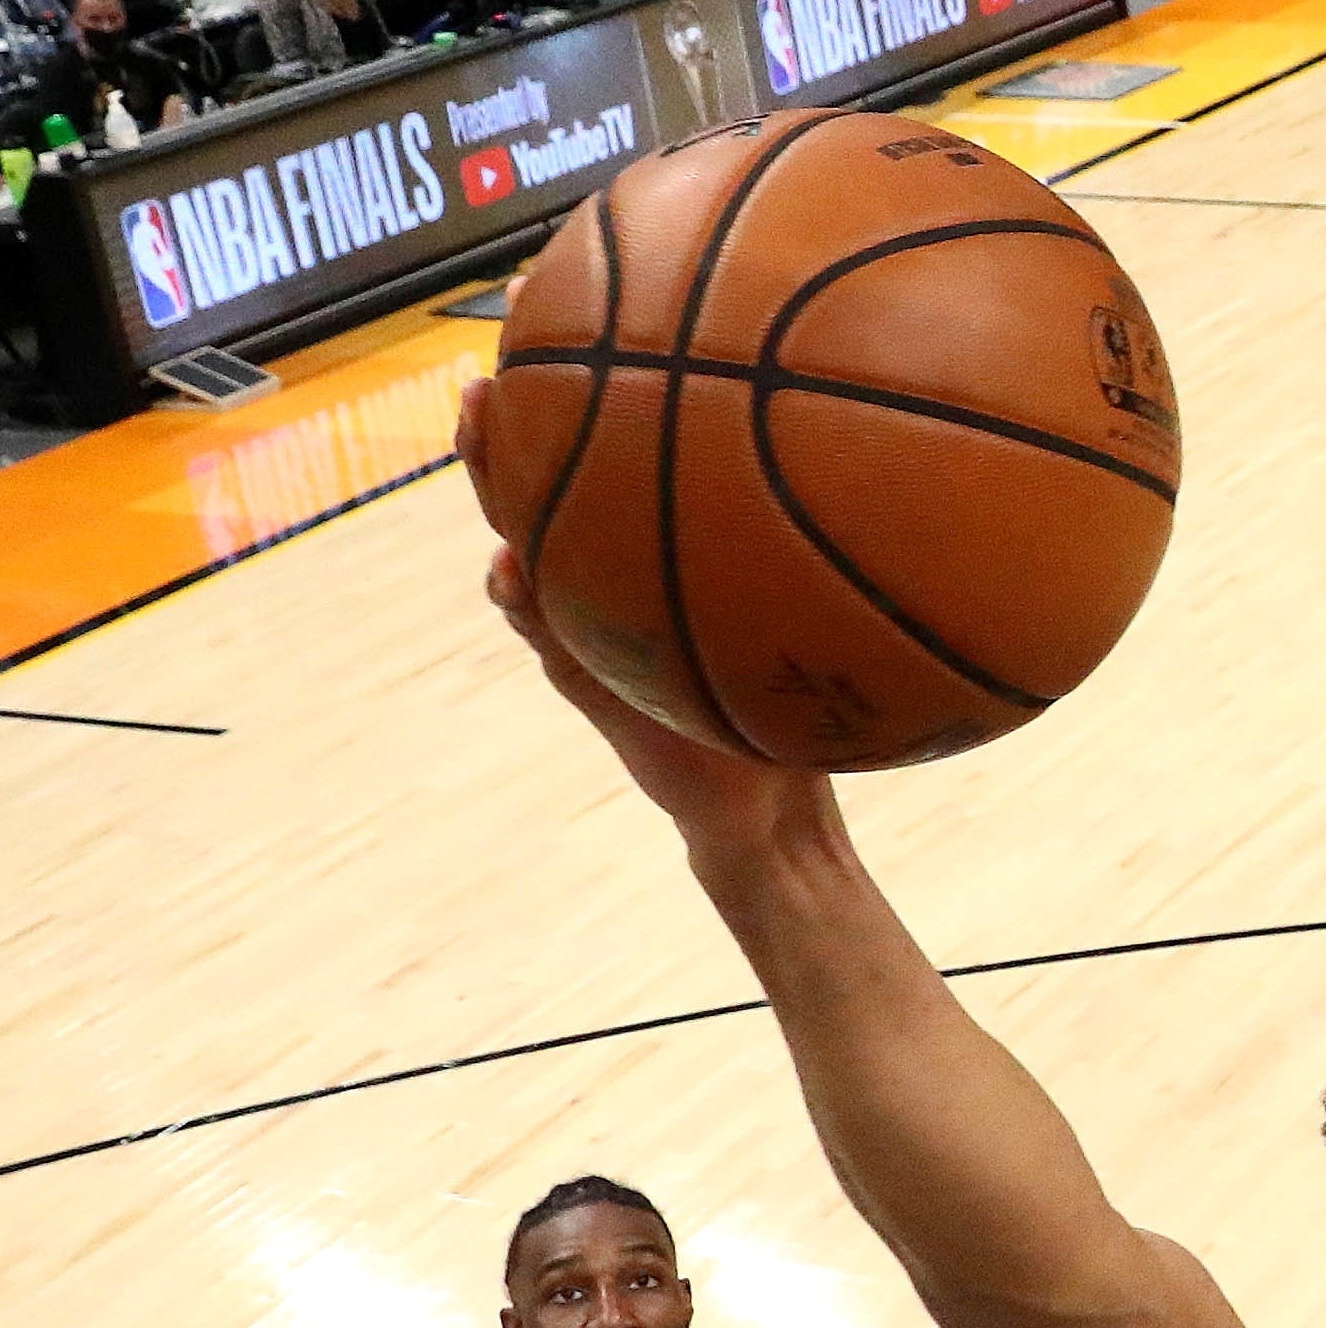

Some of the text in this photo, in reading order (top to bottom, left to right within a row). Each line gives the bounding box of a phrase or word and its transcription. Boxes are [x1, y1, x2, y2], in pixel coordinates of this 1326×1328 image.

[789, 0, 869, 83] NBA
[169, 112, 445, 308] NBA FINALS
